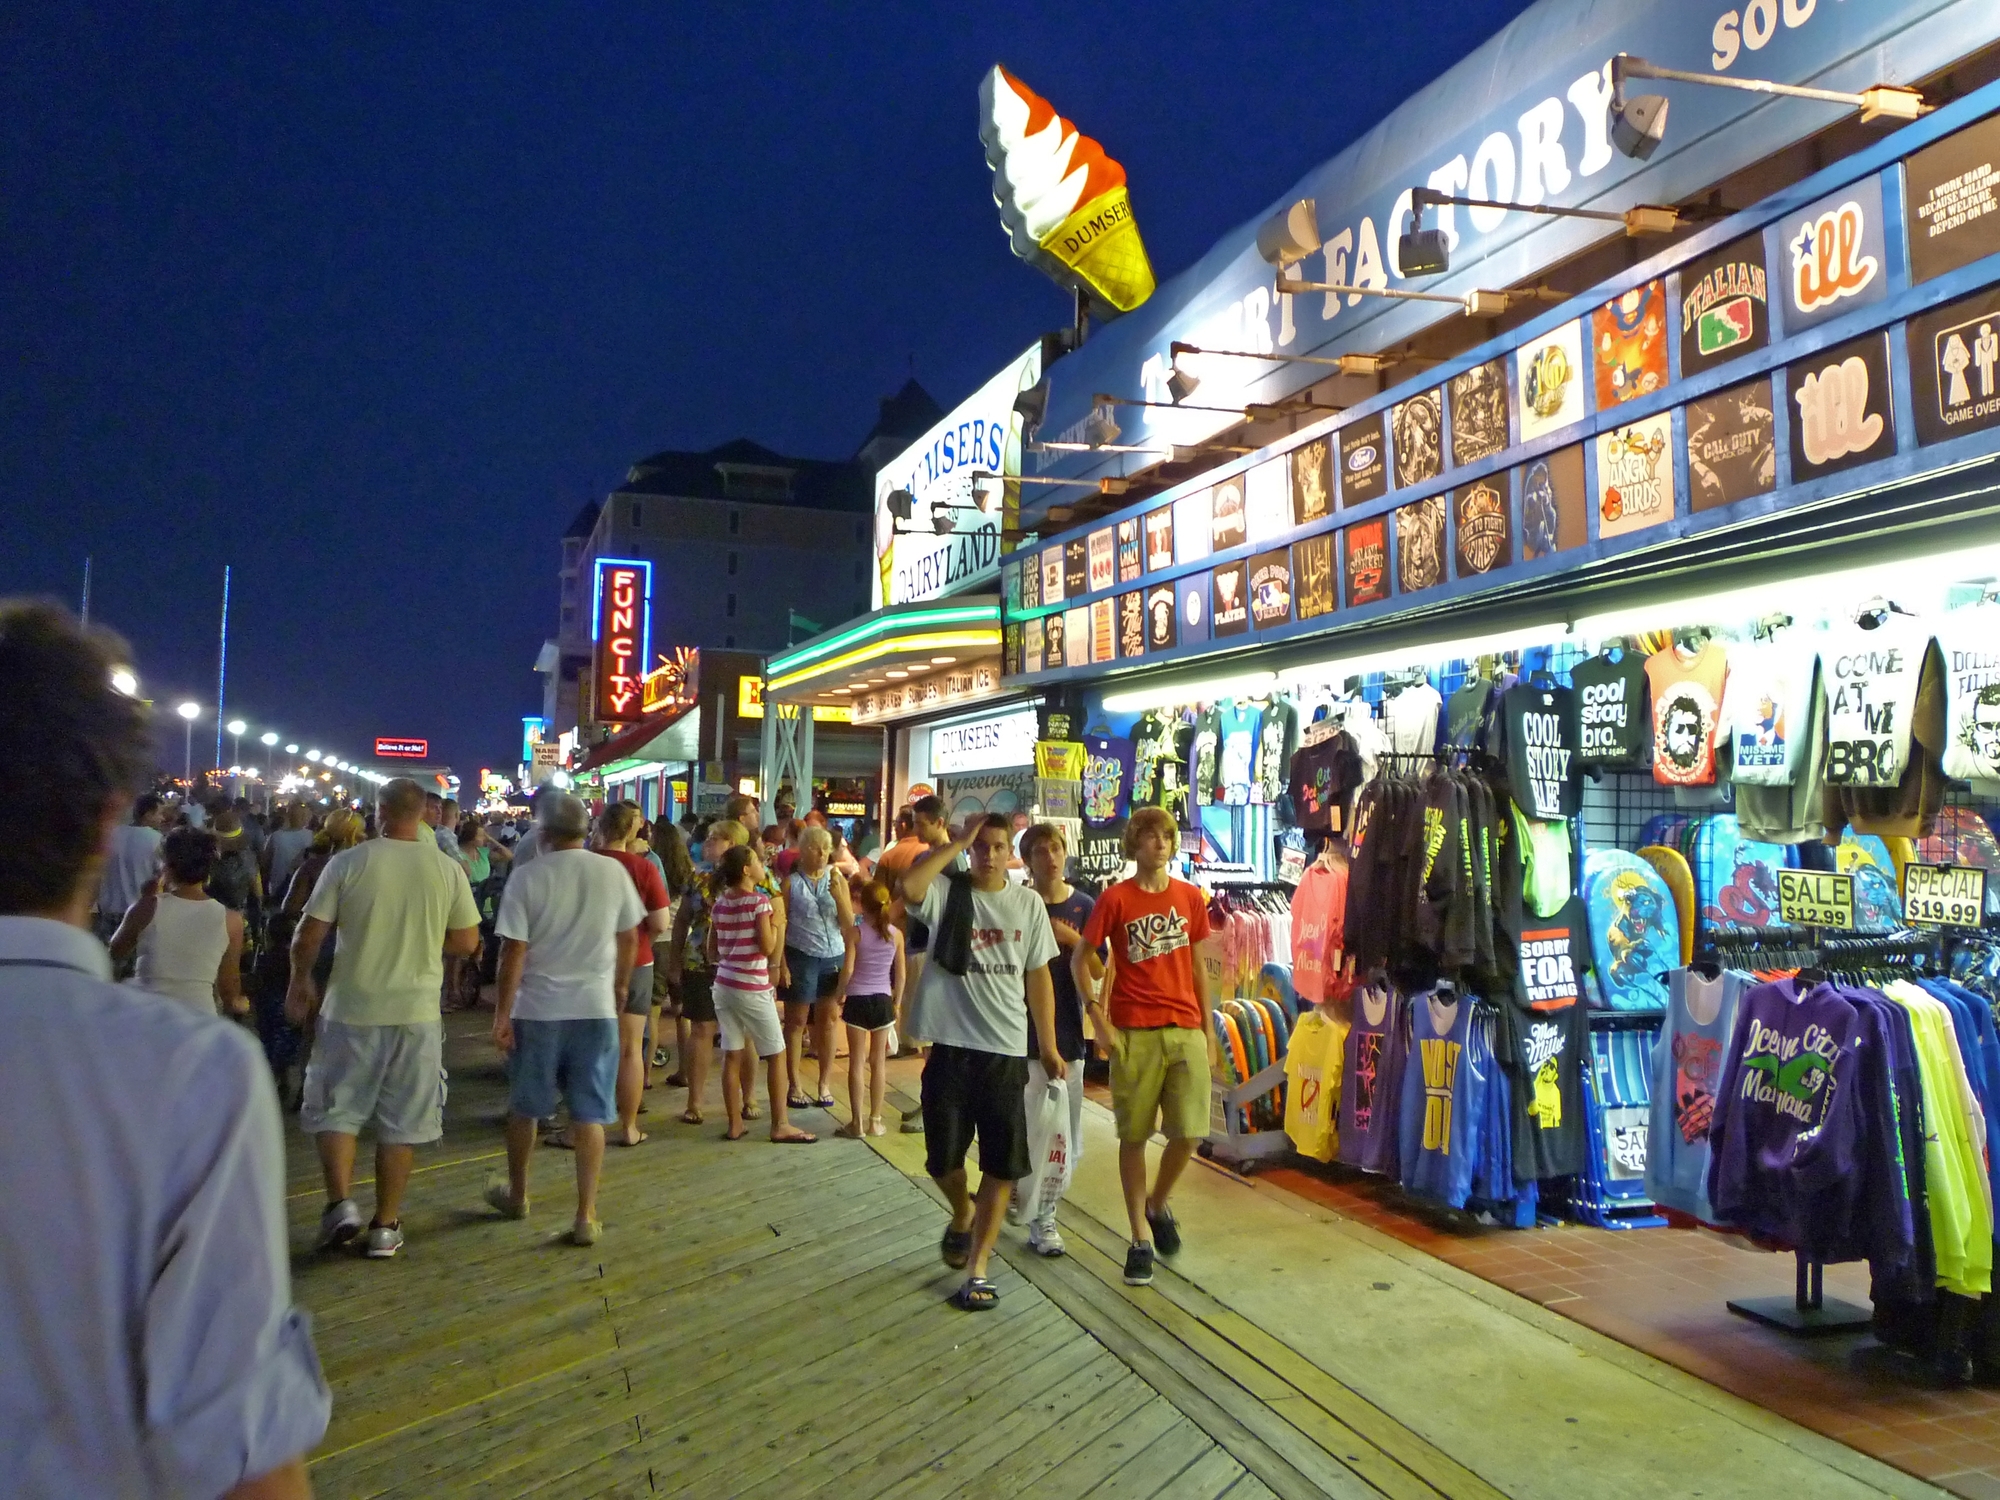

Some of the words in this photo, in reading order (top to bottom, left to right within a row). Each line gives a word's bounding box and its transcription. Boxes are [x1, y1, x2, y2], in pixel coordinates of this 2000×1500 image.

[1934, 175, 1964, 198] WORK
[1963, 163, 1992, 186] HARD
[1918, 190, 1959, 219] BECAUSE
[1928, 211, 1967, 238] DEPEND
[1967, 205, 1982, 221] ON
[1982, 197, 1999, 214] ME
[1933, 207, 1947, 224] ON
[1947, 187, 1993, 216] WELFARE
[1682, 261, 1766, 336] ITALIAN
[1945, 407, 1975, 426] GAME
[1729, 428, 1761, 451] DUTY
[1352, 449, 1372, 468] Ford
[1621, 478, 1662, 517] BIRDS
[1484, 517, 1504, 532] FIGHT
[1214, 608, 1246, 626] PLAYER
[1835, 648, 1904, 679] COME
[944, 672, 974, 697] ITALIAN
[976, 668, 990, 690] ICE
[1582, 676, 1626, 705] cool
[1833, 680, 1869, 716] AT
[1523, 711, 1562, 748] COOL
[1581, 702, 1628, 728] story
[1864, 700, 1897, 735] ME
[1581, 723, 1617, 748] bro.
[1740, 744, 1766, 755] MISS
[1770, 743, 1786, 754] ME
[1526, 745, 1572, 782] STORY
[1741, 753, 1784, 765] YET?
[1827, 738, 1895, 783] BRO
[1780, 874, 1851, 906] SALE
[1908, 867, 1981, 901] SPECIAL
[1786, 905, 1846, 926] $12.99
[1909, 897, 1978, 924] $19.99
[1125, 906, 1188, 949] RVCA
[1520, 938, 1570, 959] SORRY
[1521, 954, 1575, 987] FOR
[1531, 1021, 1559, 1042] Mac
